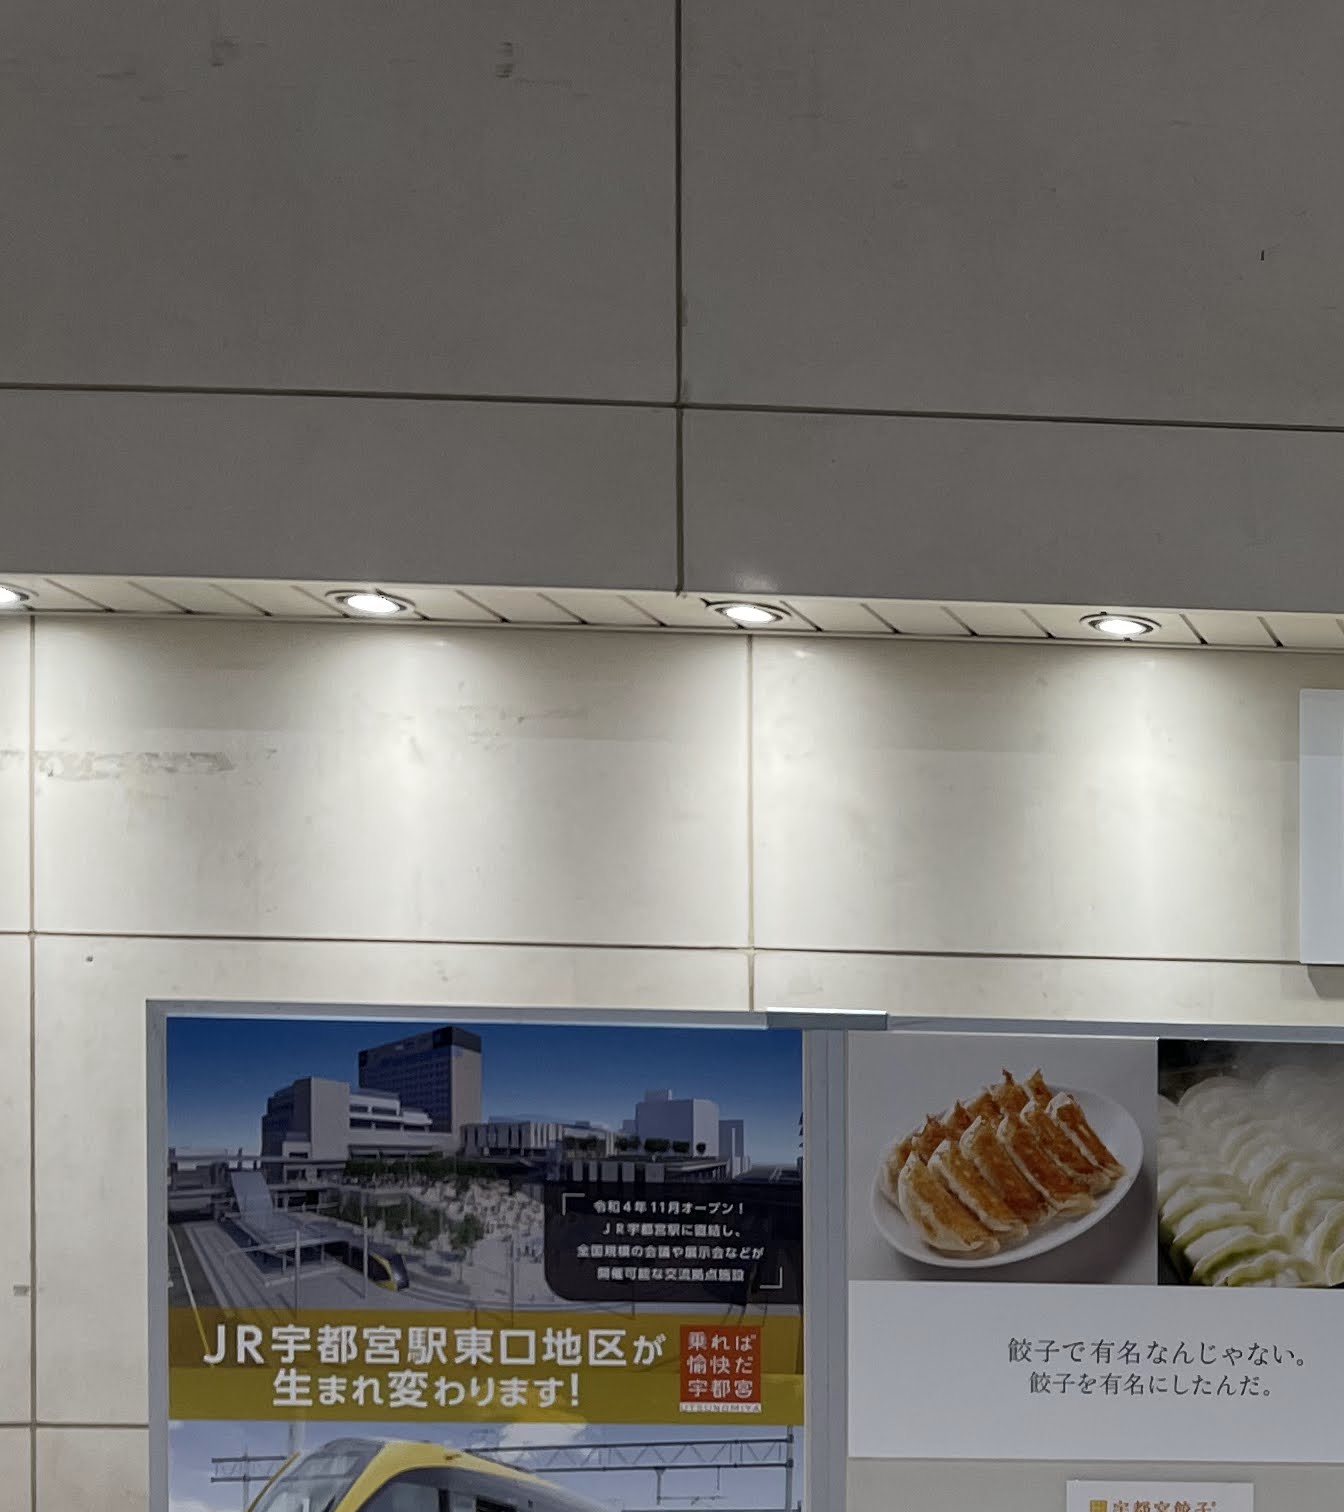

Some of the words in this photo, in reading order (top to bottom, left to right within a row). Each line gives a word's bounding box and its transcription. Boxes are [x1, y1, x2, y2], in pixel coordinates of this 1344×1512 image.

[203, 1324, 668, 1367] JR宇都宮駅東口地区が
[687, 1330, 757, 1352] 乗れば
[1007, 1337, 1306, 1368] 餃子で有名なんじゃない。
[686, 1353, 754, 1375] 愉快だ
[272, 1368, 580, 1409] 生まれ変わります!
[687, 1378, 753, 1399] 宇都宮
[1029, 1371, 1273, 1399] 餃子を有名にしたんだ。
